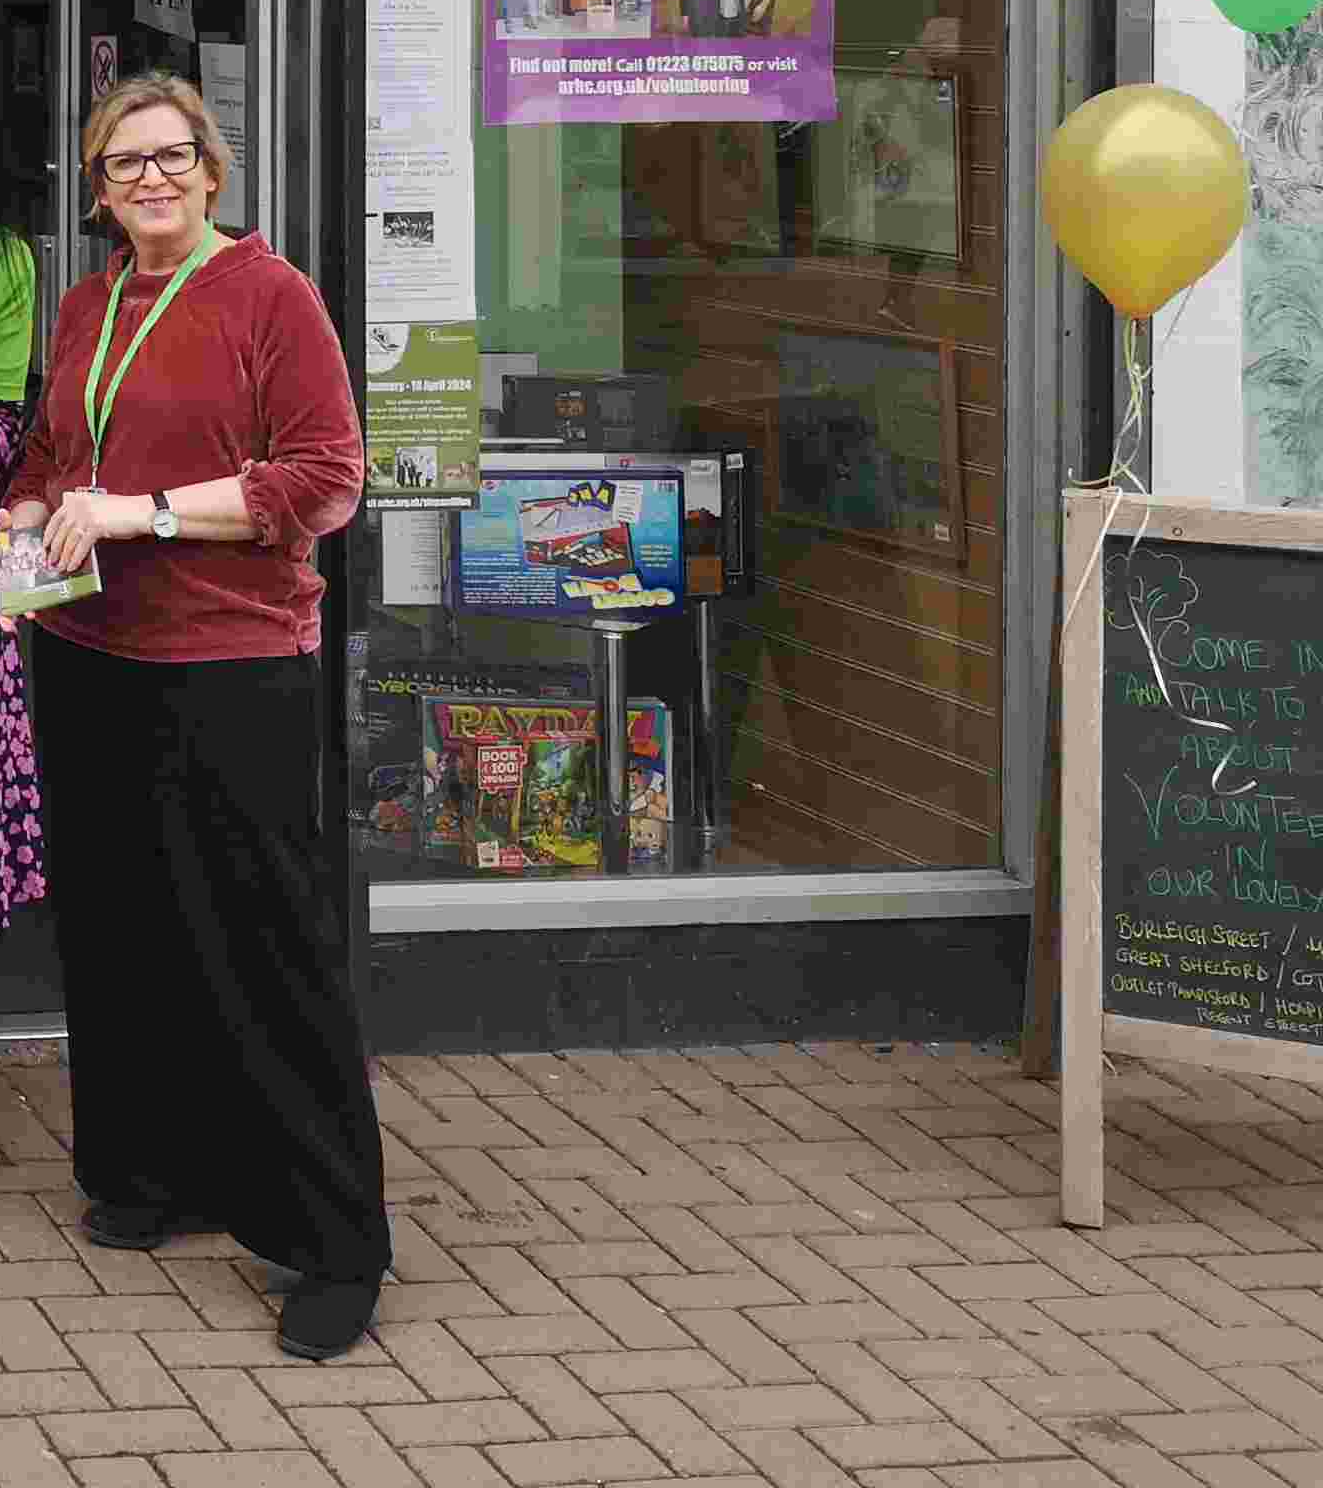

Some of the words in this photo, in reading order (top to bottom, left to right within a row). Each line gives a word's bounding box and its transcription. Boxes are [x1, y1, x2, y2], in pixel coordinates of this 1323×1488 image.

[509, 57, 541, 73] Find
[542, 59, 567, 73] out
[569, 57, 612, 73] more!
[616, 57, 645, 72] Call
[646, 56, 690, 72] 01223
[747, 60, 764, 71] or
[766, 56, 798, 72] visit
[1158, 619, 1272, 674] COME
[1169, 678, 1258, 719] TALK
[1261, 684, 1305, 720] TO
[481, 751, 519, 762] BOOK
[1181, 735, 1300, 774] ABOUT
[1225, 839, 1267, 874] IN
[1147, 864, 1219, 898] OUR
[1115, 913, 1207, 944] BURLEIGH
[1211, 923, 1272, 950] STREET
[1115, 947, 1172, 968] GREAT
[1179, 956, 1269, 982] SHELFORD
